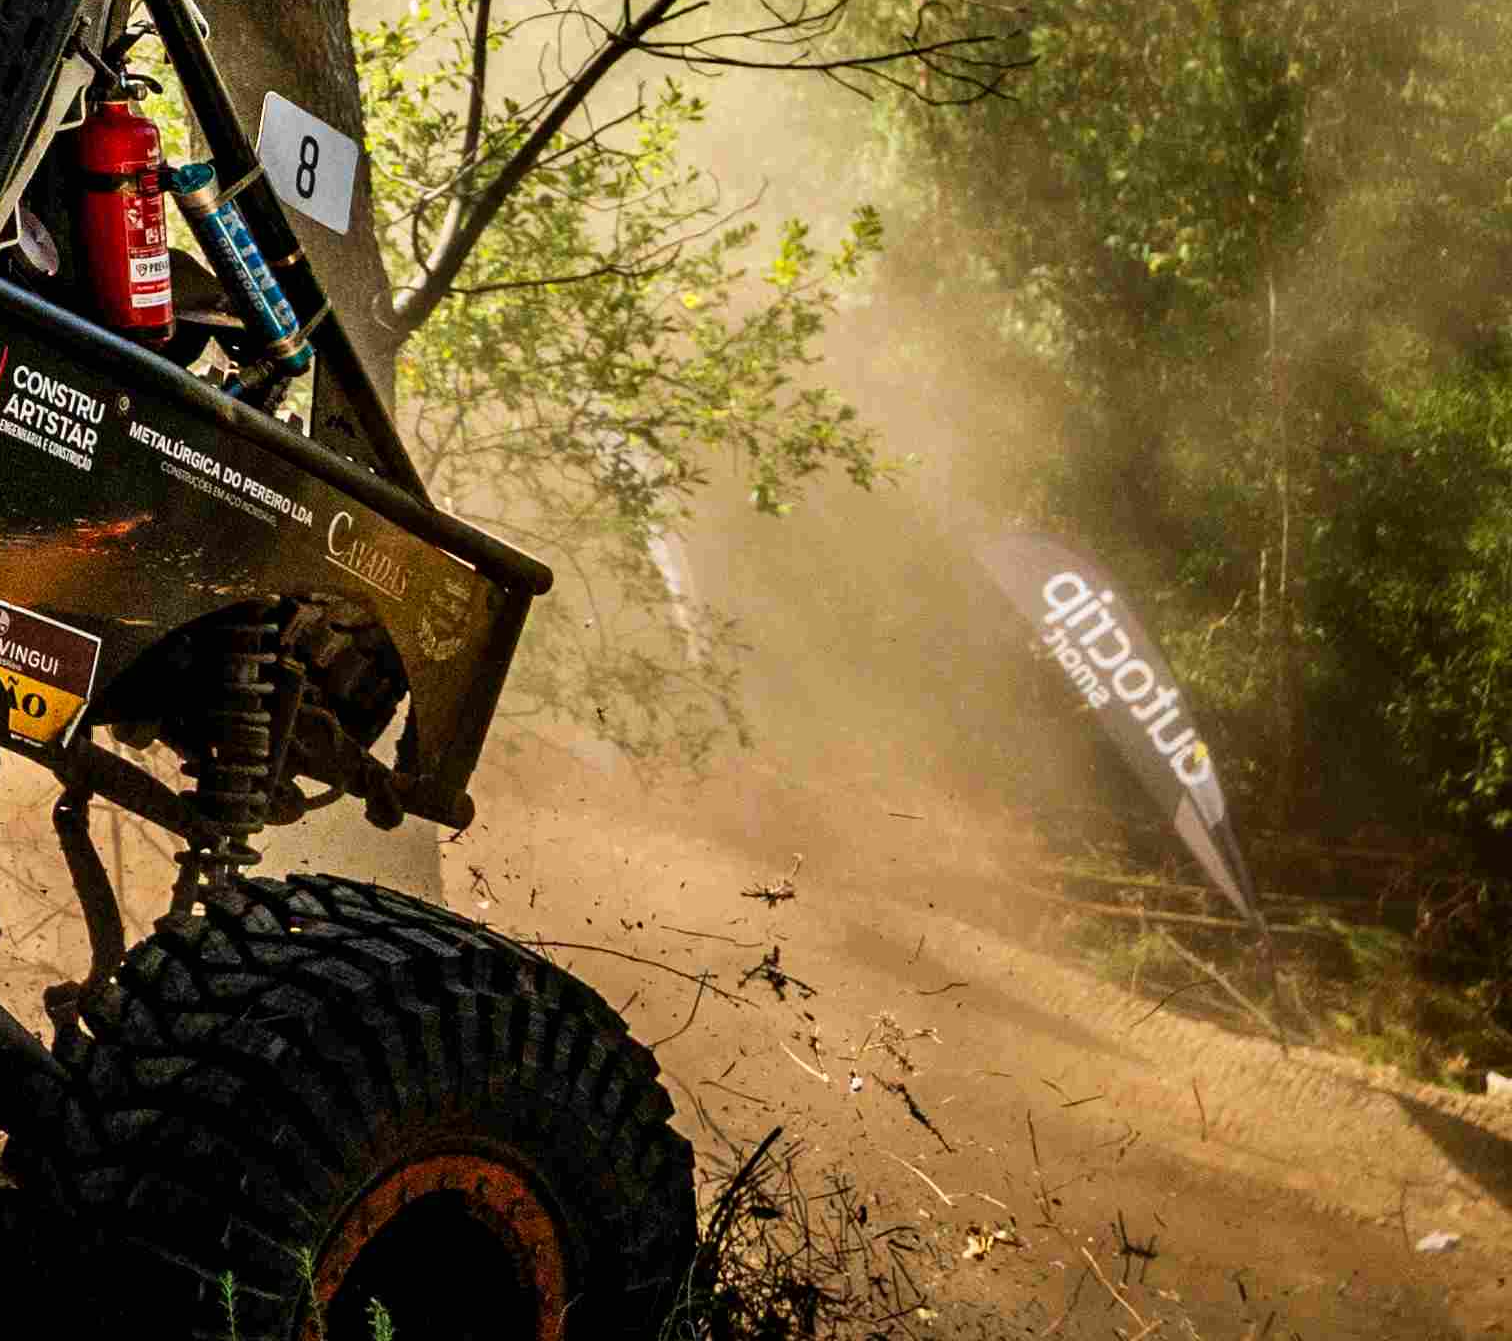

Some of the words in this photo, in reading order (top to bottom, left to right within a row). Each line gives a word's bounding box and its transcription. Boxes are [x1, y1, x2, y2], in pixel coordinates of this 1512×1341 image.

[295, 135, 320, 200] 8
[2, 393, 99, 454] ARTSTAR
[13, 365, 106, 424] CONSTRU
[129, 420, 221, 481] METALÚRGICA
[222, 466, 243, 488] DO
[243, 476, 291, 515] PEREIRO
[291, 501, 314, 527] LDA
